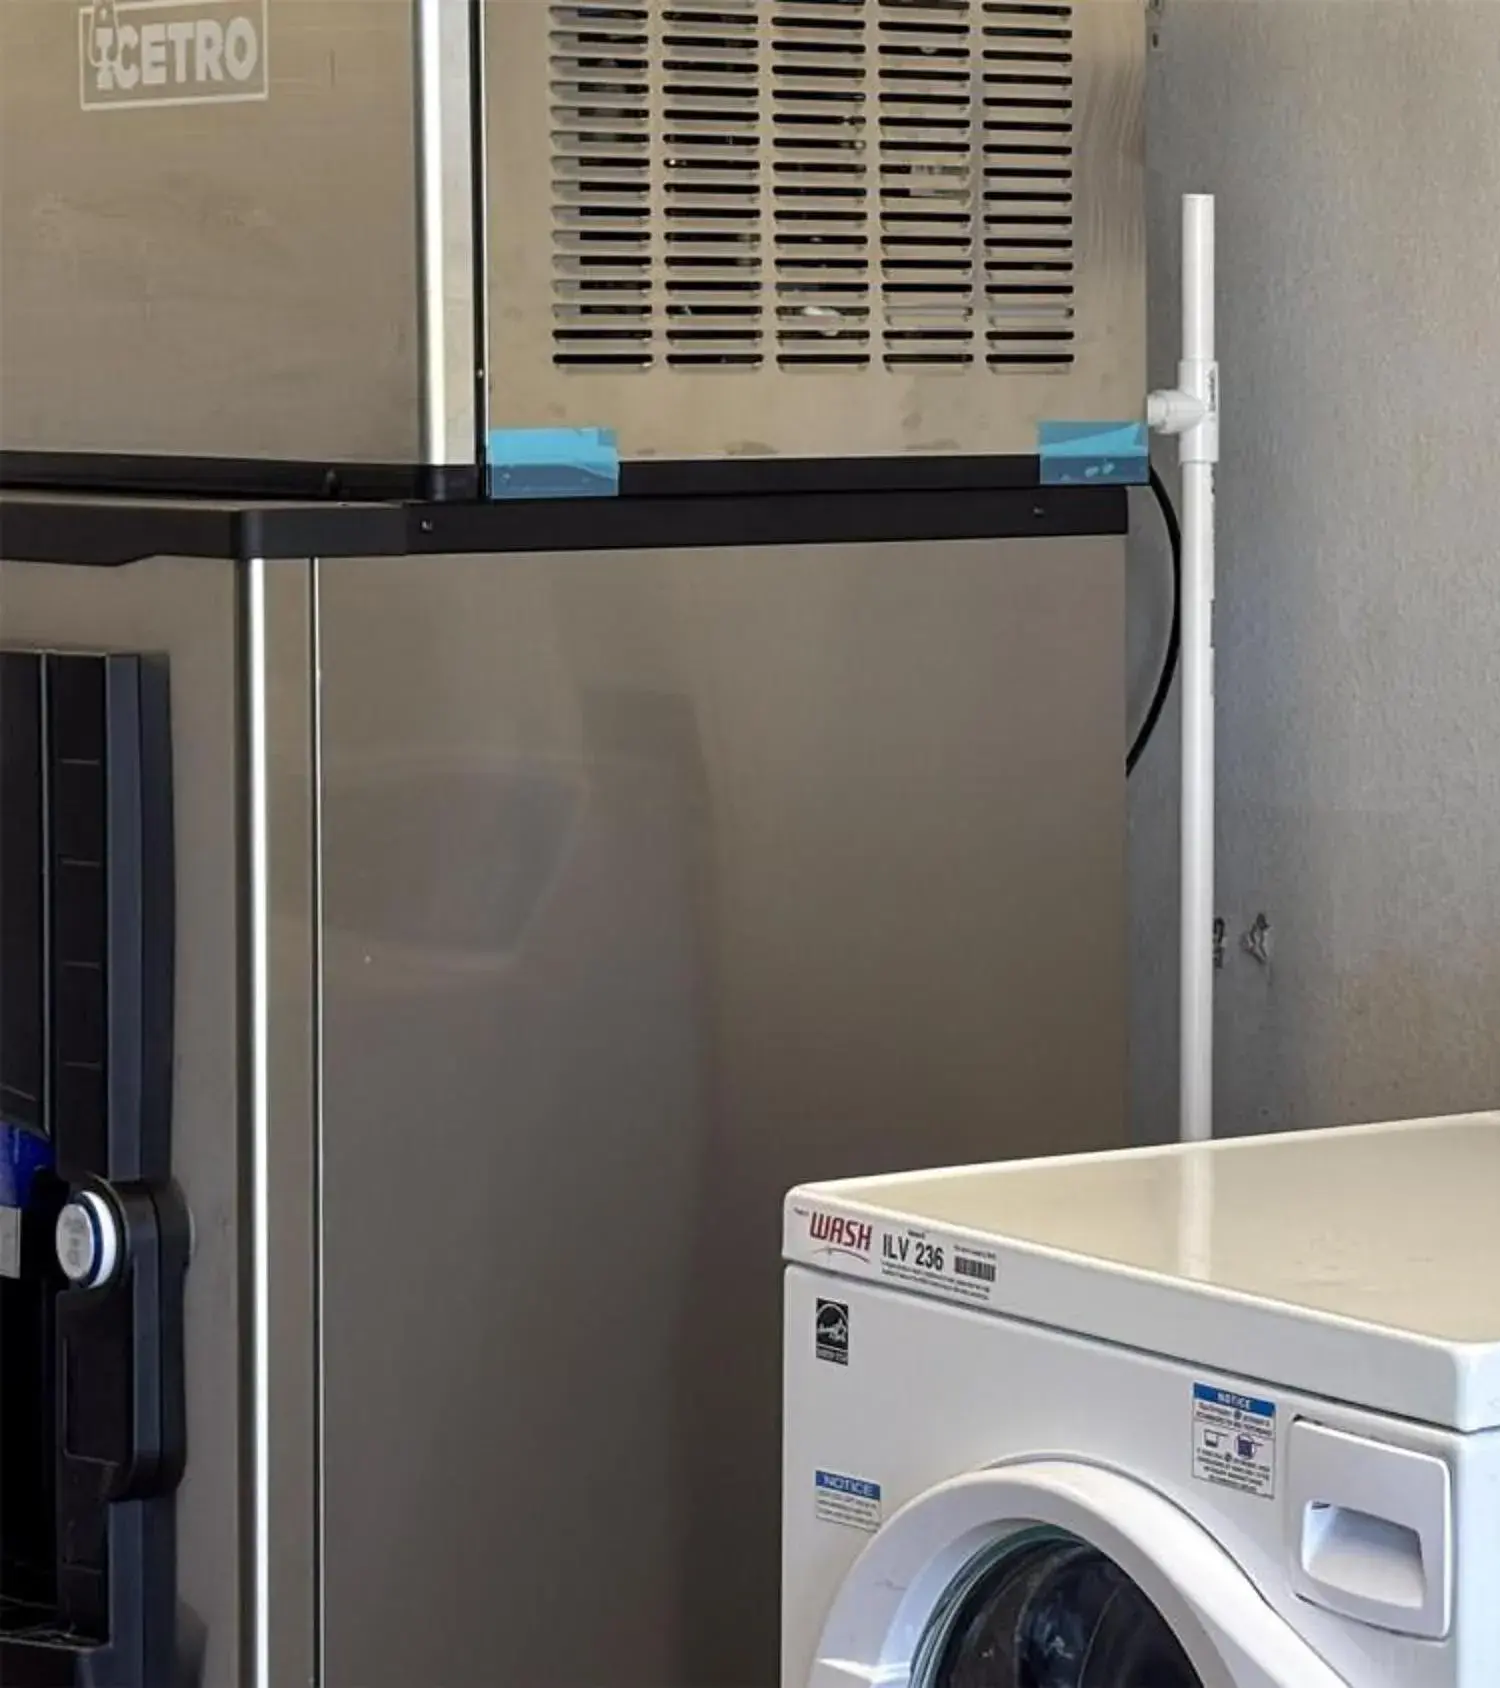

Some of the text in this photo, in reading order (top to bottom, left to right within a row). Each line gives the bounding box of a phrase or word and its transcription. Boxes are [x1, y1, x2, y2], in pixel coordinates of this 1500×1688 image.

[95, 17, 257, 90] ICETRO
[808, 1212, 873, 1252] WASH
[883, 1233, 911, 1263] ILV
[915, 1241, 944, 1272] 236
[823, 1474, 875, 1498] NOTICE
